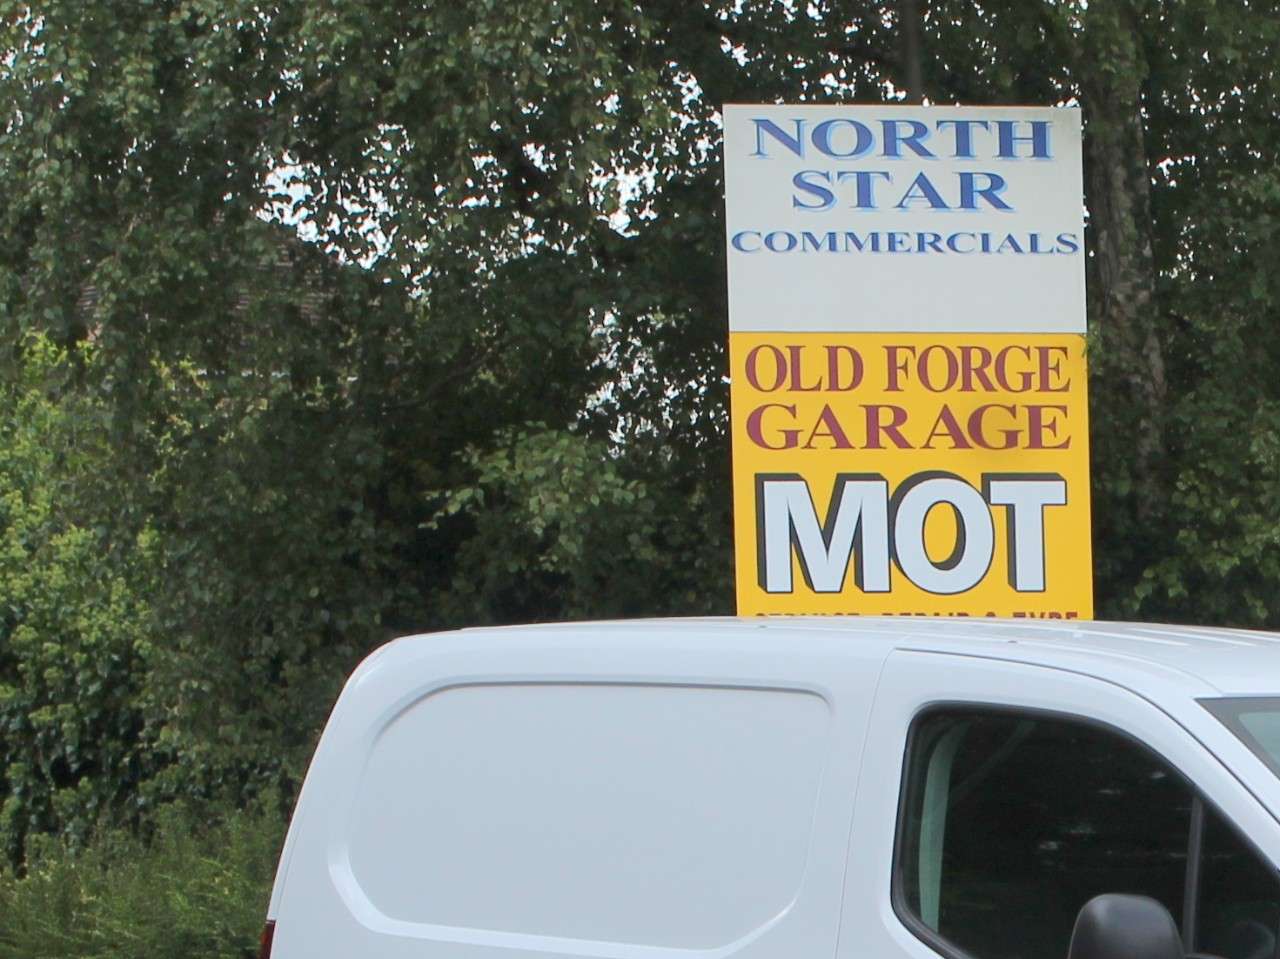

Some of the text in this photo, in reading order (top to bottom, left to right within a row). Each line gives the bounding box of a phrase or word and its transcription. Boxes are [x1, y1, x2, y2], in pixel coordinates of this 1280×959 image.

[749, 118, 1054, 160] NORTH
[792, 169, 1014, 212] STAR
[731, 230, 1080, 254] COMMERCIALS
[744, 344, 1072, 392] OLD FORGE
[745, 403, 1072, 450] GARAGE
[754, 470, 1067, 594] MOT
